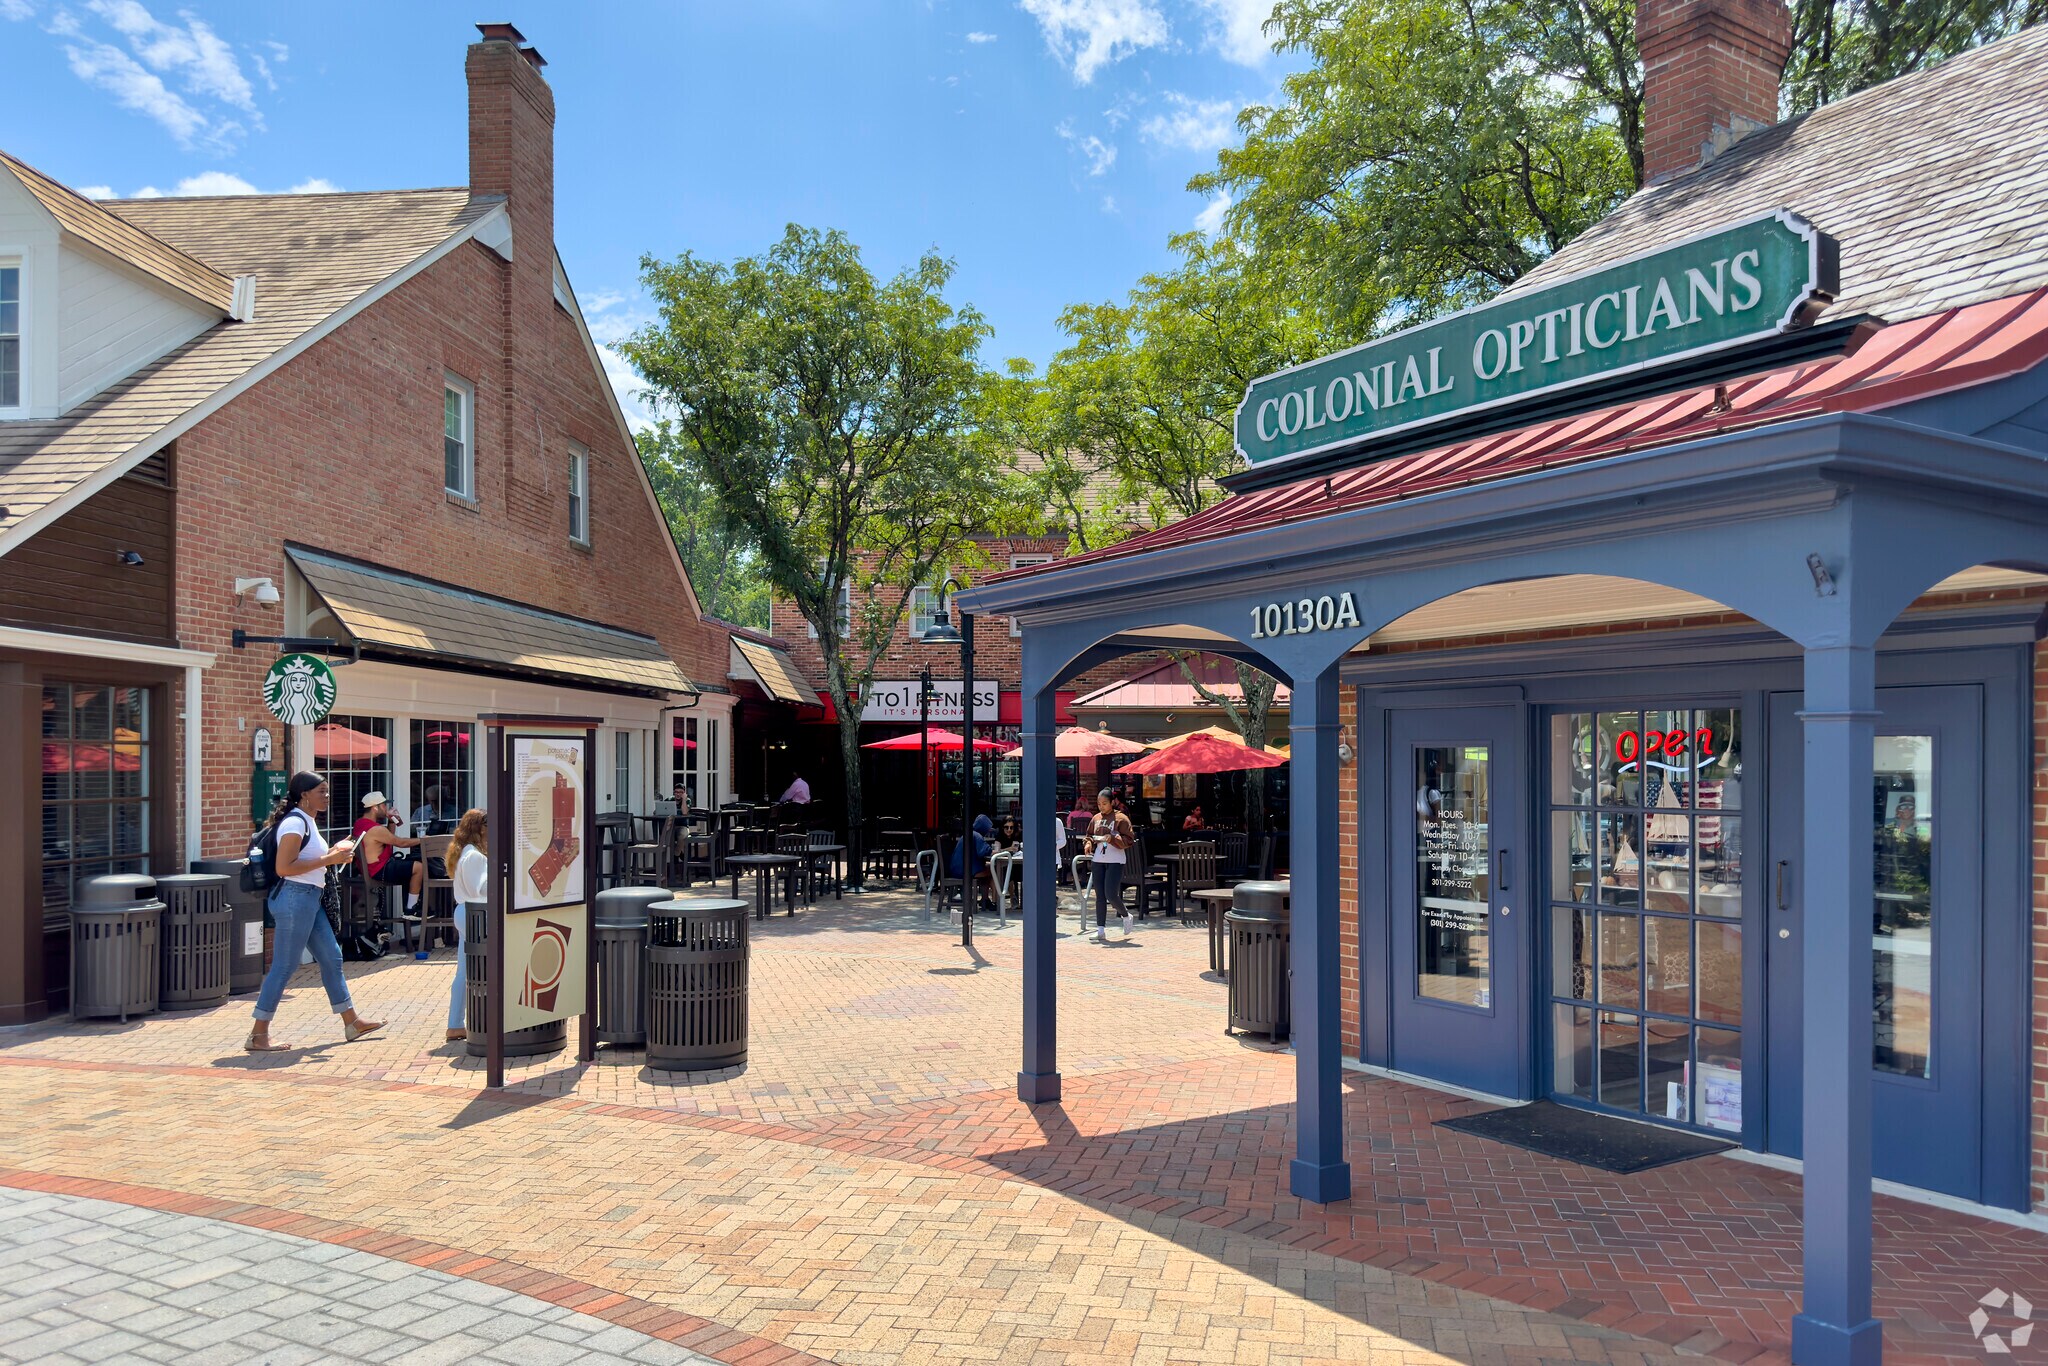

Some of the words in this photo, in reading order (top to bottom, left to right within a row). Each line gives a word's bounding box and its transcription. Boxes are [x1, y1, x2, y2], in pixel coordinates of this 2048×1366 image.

[1256, 347, 1455, 442] COLONIAL
[1473, 248, 1762, 381] OPTICIANS
[1250, 591, 1360, 639] 10130A
[916, 692, 995, 707] FTNESS
[884, 708, 906, 716] IT'S
[912, 708, 966, 716] PRSONA
[1437, 810, 1464, 819] HOURS
[1427, 850, 1457, 861] Satuday
[1431, 863, 1452, 872] Sunay
